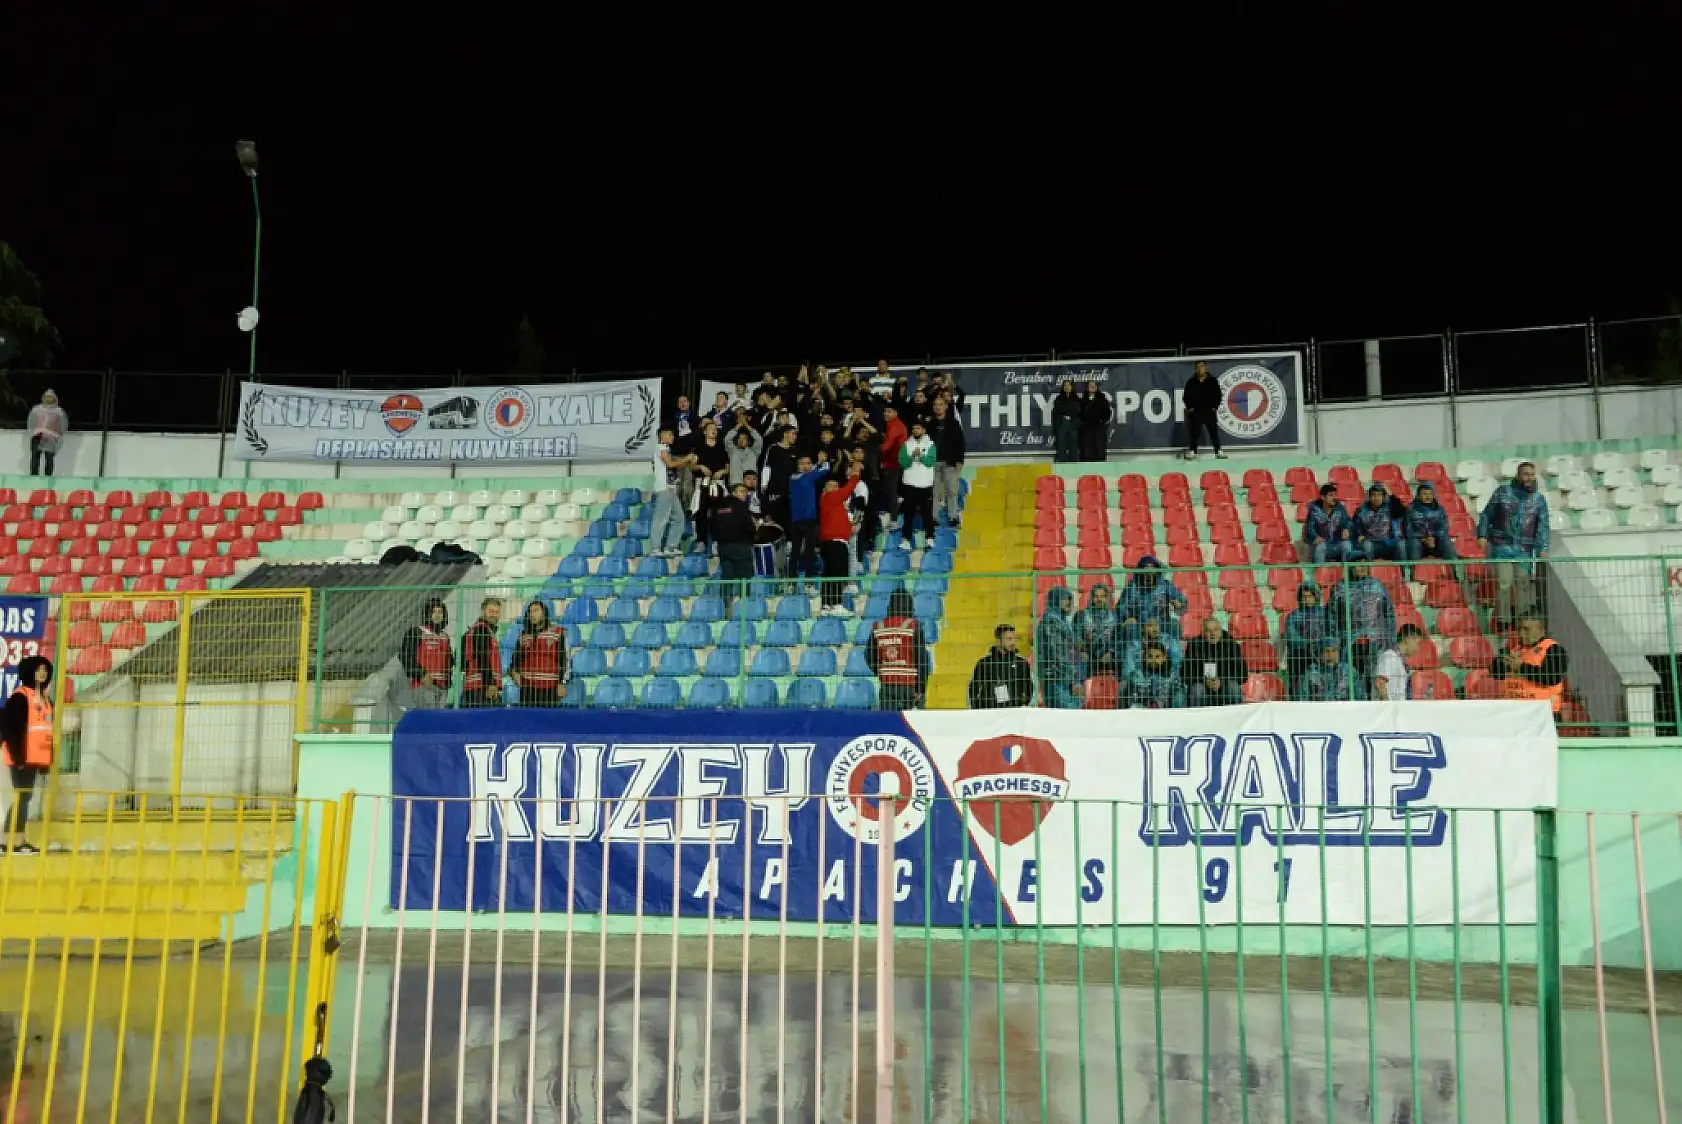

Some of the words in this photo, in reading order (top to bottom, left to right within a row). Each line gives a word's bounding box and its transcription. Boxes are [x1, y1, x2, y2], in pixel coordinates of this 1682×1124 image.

[262, 394, 373, 429] KUZEY
[538, 392, 633, 426] KALE
[316, 438, 442, 460] DEPLASMAN
[450, 432, 578, 460] KUVVETLERİ
[1000, 430, 1022, 445] Biz
[832, 737, 897, 814] FETHİYESPOR
[961, 777, 1061, 797] APACHES91
[1138, 732, 1448, 847] KALE
[465, 743, 815, 845] KUZEY
